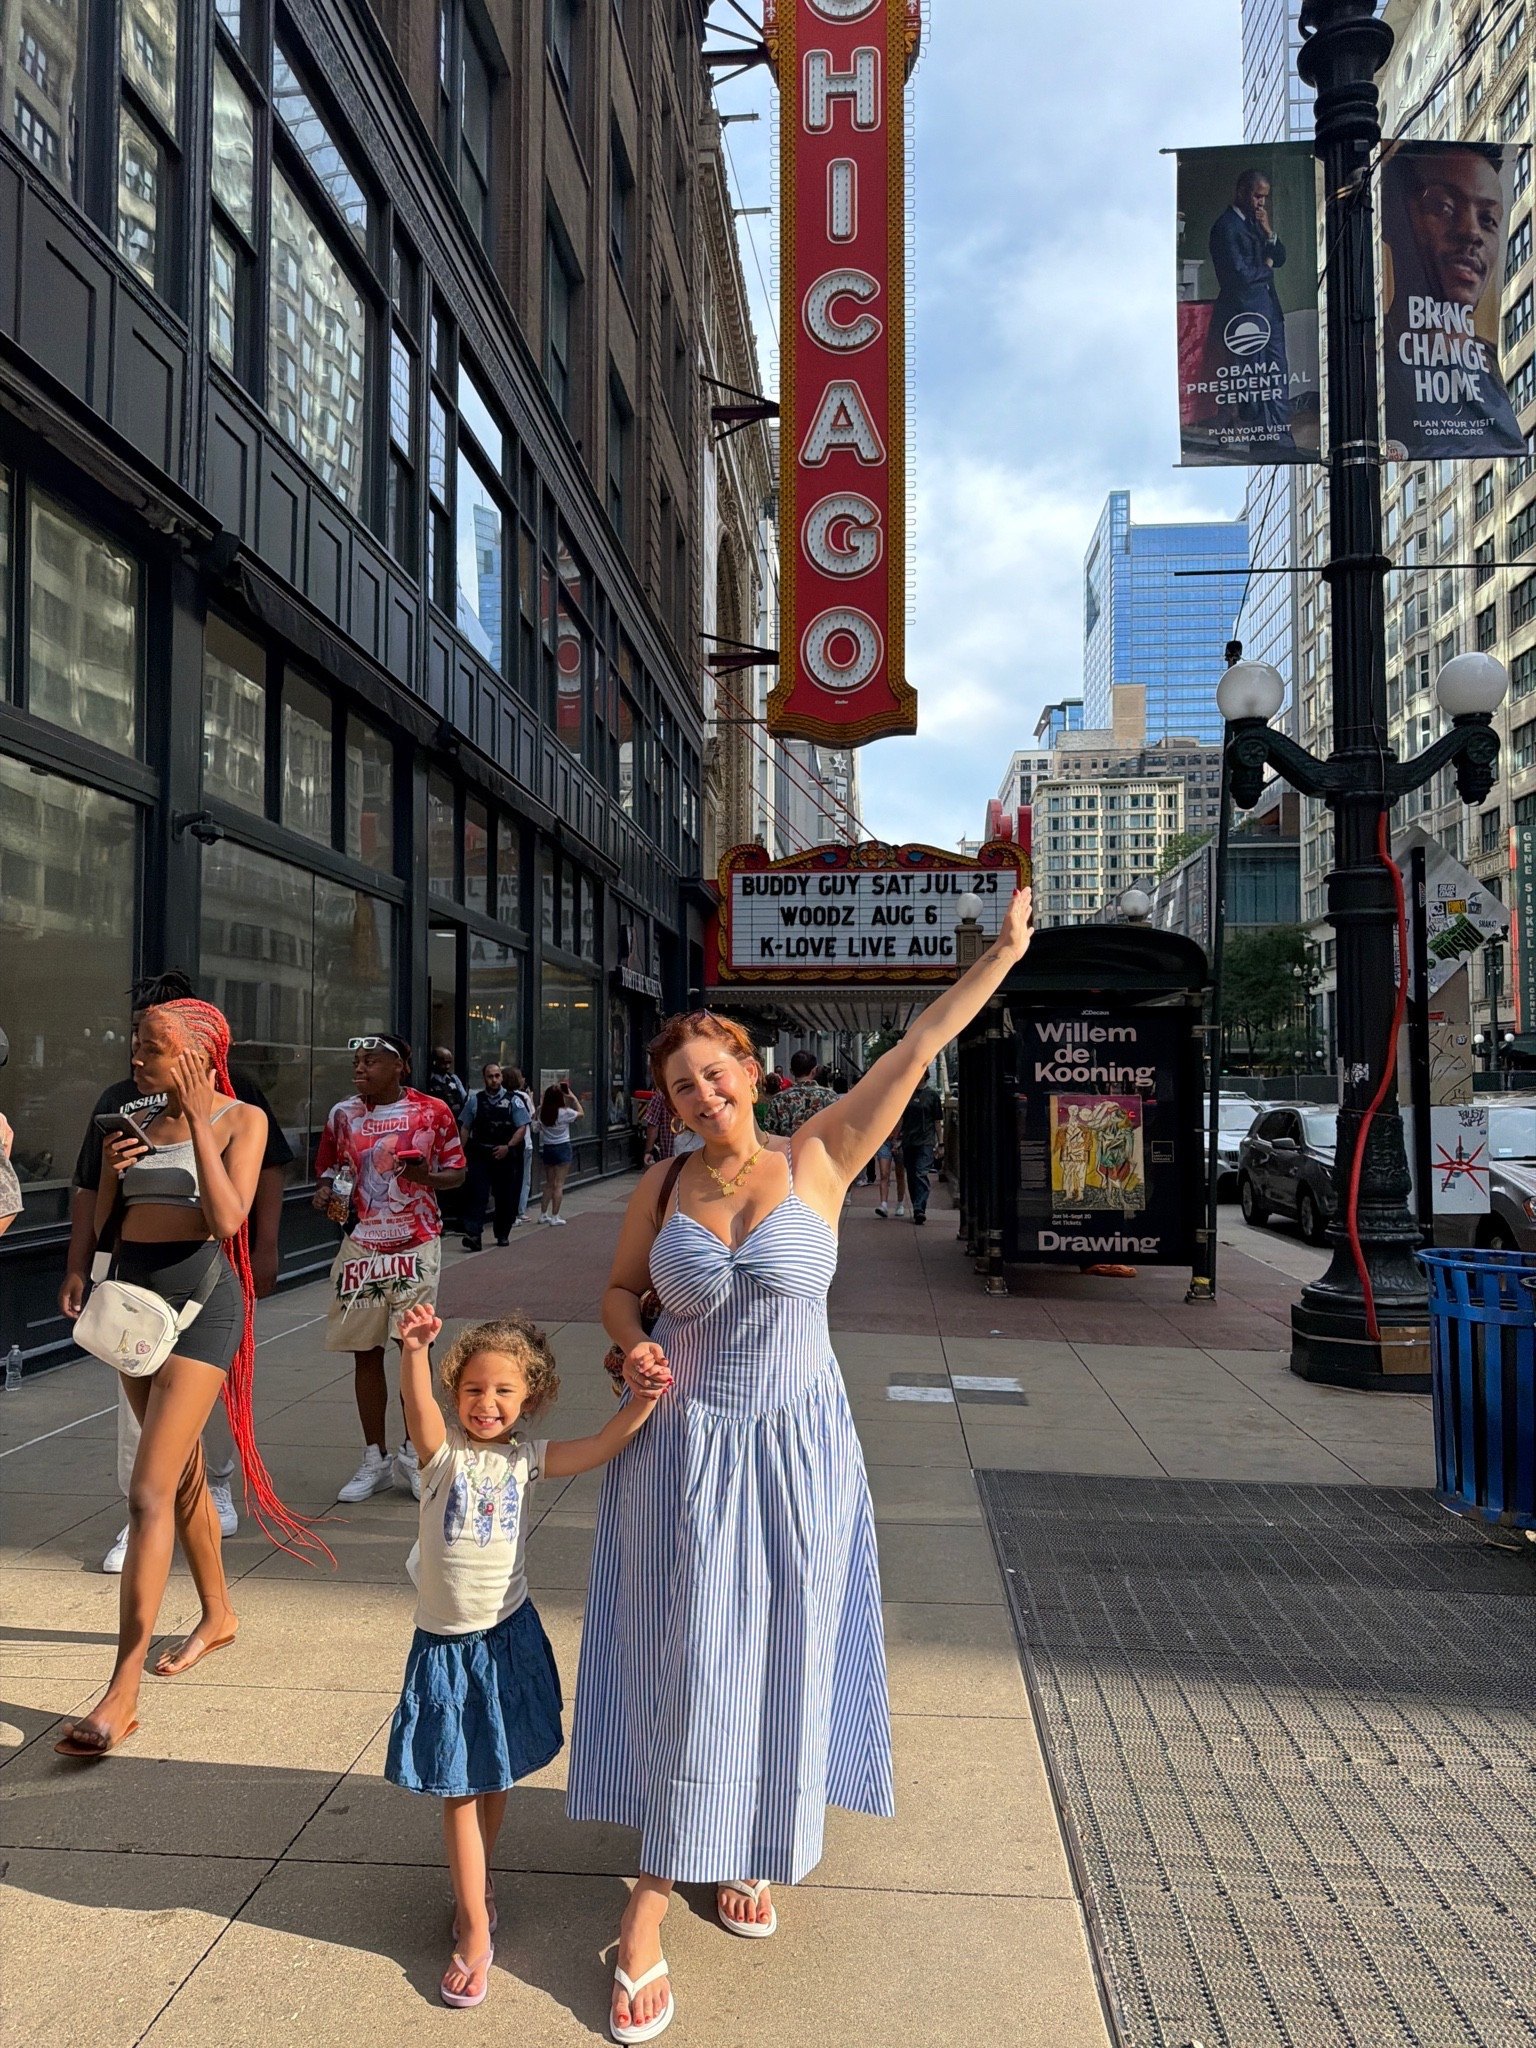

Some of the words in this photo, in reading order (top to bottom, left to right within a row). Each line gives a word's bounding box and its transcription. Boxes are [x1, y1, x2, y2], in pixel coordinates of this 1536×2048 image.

[1398, 331, 1490, 374] CHANGE
[1215, 361, 1281, 379] OBAMA
[1186, 371, 1312, 395] PRESIDENTIAL
[1414, 369, 1485, 404] HOME
[1214, 387, 1283, 406] CENTER
[1208, 426, 1234, 437] PLAN
[1237, 425, 1265, 436] YOUR
[1266, 424, 1292, 434] VISIT
[1412, 418, 1438, 429] PLAN
[1441, 418, 1469, 429] YOUR
[1469, 417, 1496, 428] VISIT
[1424, 426, 1484, 437] OBAMA.ORG
[1219, 433, 1281, 445] OBAMA.ORG
[1522, 832, 1533, 875] GENE
[741, 875, 810, 896] BUDDY
[818, 874, 861, 896] GUY
[871, 873, 915, 895] SAT
[920, 873, 963, 895] JUL
[972, 872, 998, 894] 25
[780, 905, 856, 927] WOODZ
[871, 905, 915, 926] AUG
[924, 904, 938, 924] 6
[1524, 882, 1534, 949] SISKEL
[760, 936, 838, 958] K-LOVE
[848, 935, 897, 957] LIVE
[907, 935, 953, 957] AUG
[1035, 1022, 1137, 1043] Willem
[1054, 1044, 1090, 1064] de
[1035, 1062, 1155, 1087] Kooning
[1038, 1231, 1160, 1254] Drawing
[343, 1255, 415, 1292] ROLLIN
